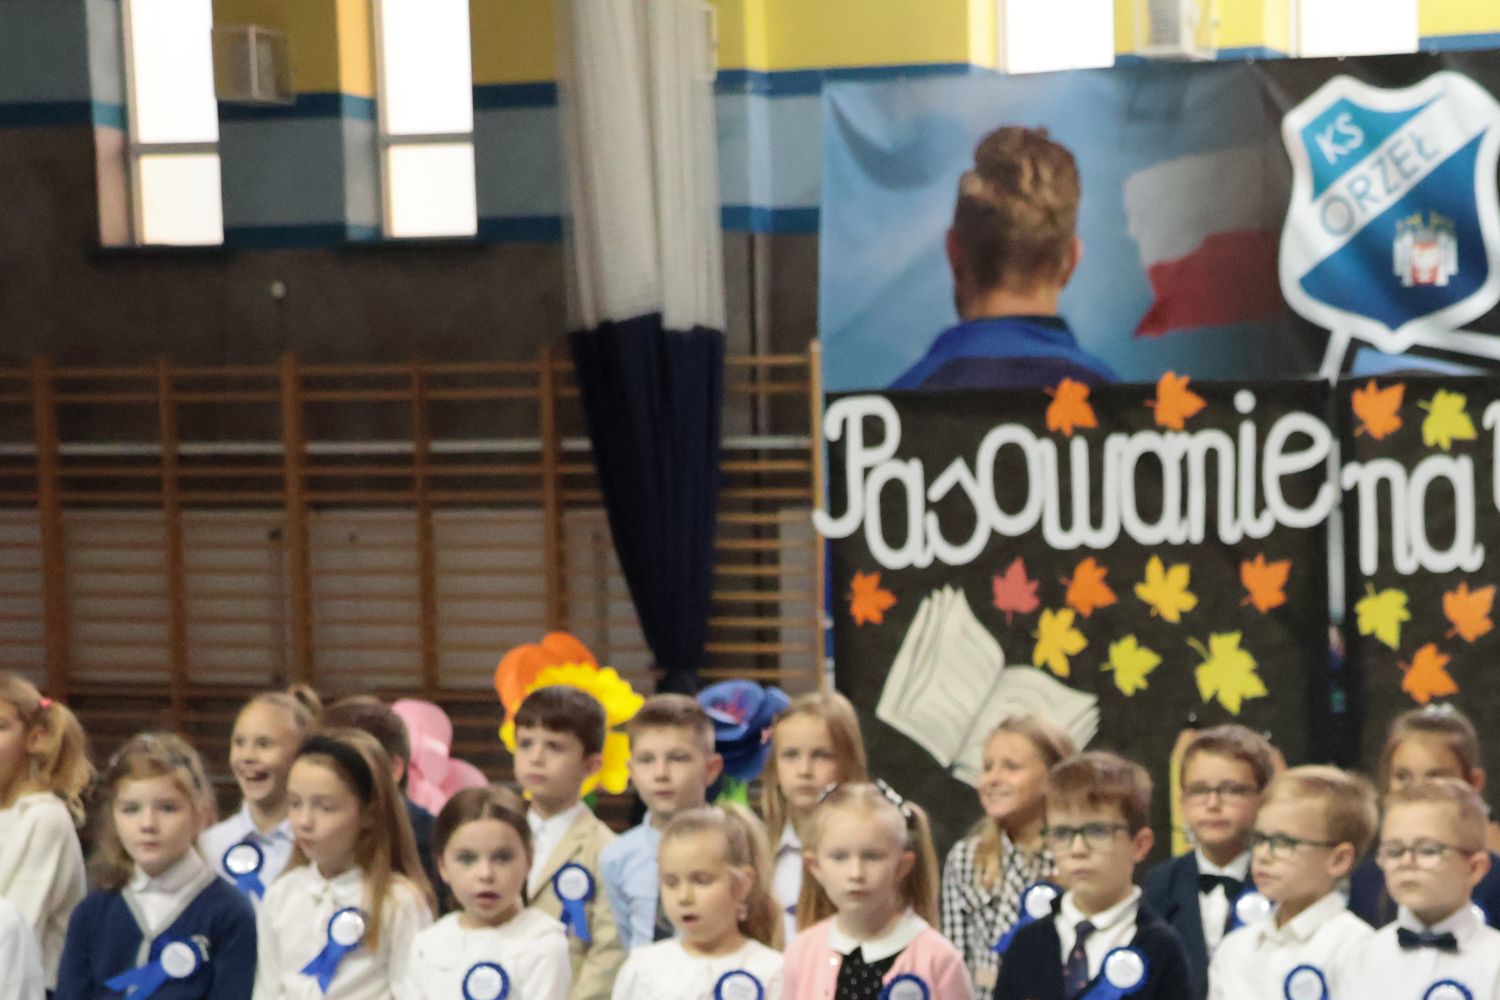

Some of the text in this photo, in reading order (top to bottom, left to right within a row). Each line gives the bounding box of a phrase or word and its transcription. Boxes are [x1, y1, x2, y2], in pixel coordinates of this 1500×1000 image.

[1315, 111, 1364, 166] KS
[1320, 131, 1440, 237] ORZEŁ
[813, 390, 1341, 570] Pasowanie
[1342, 453, 1484, 575] na
